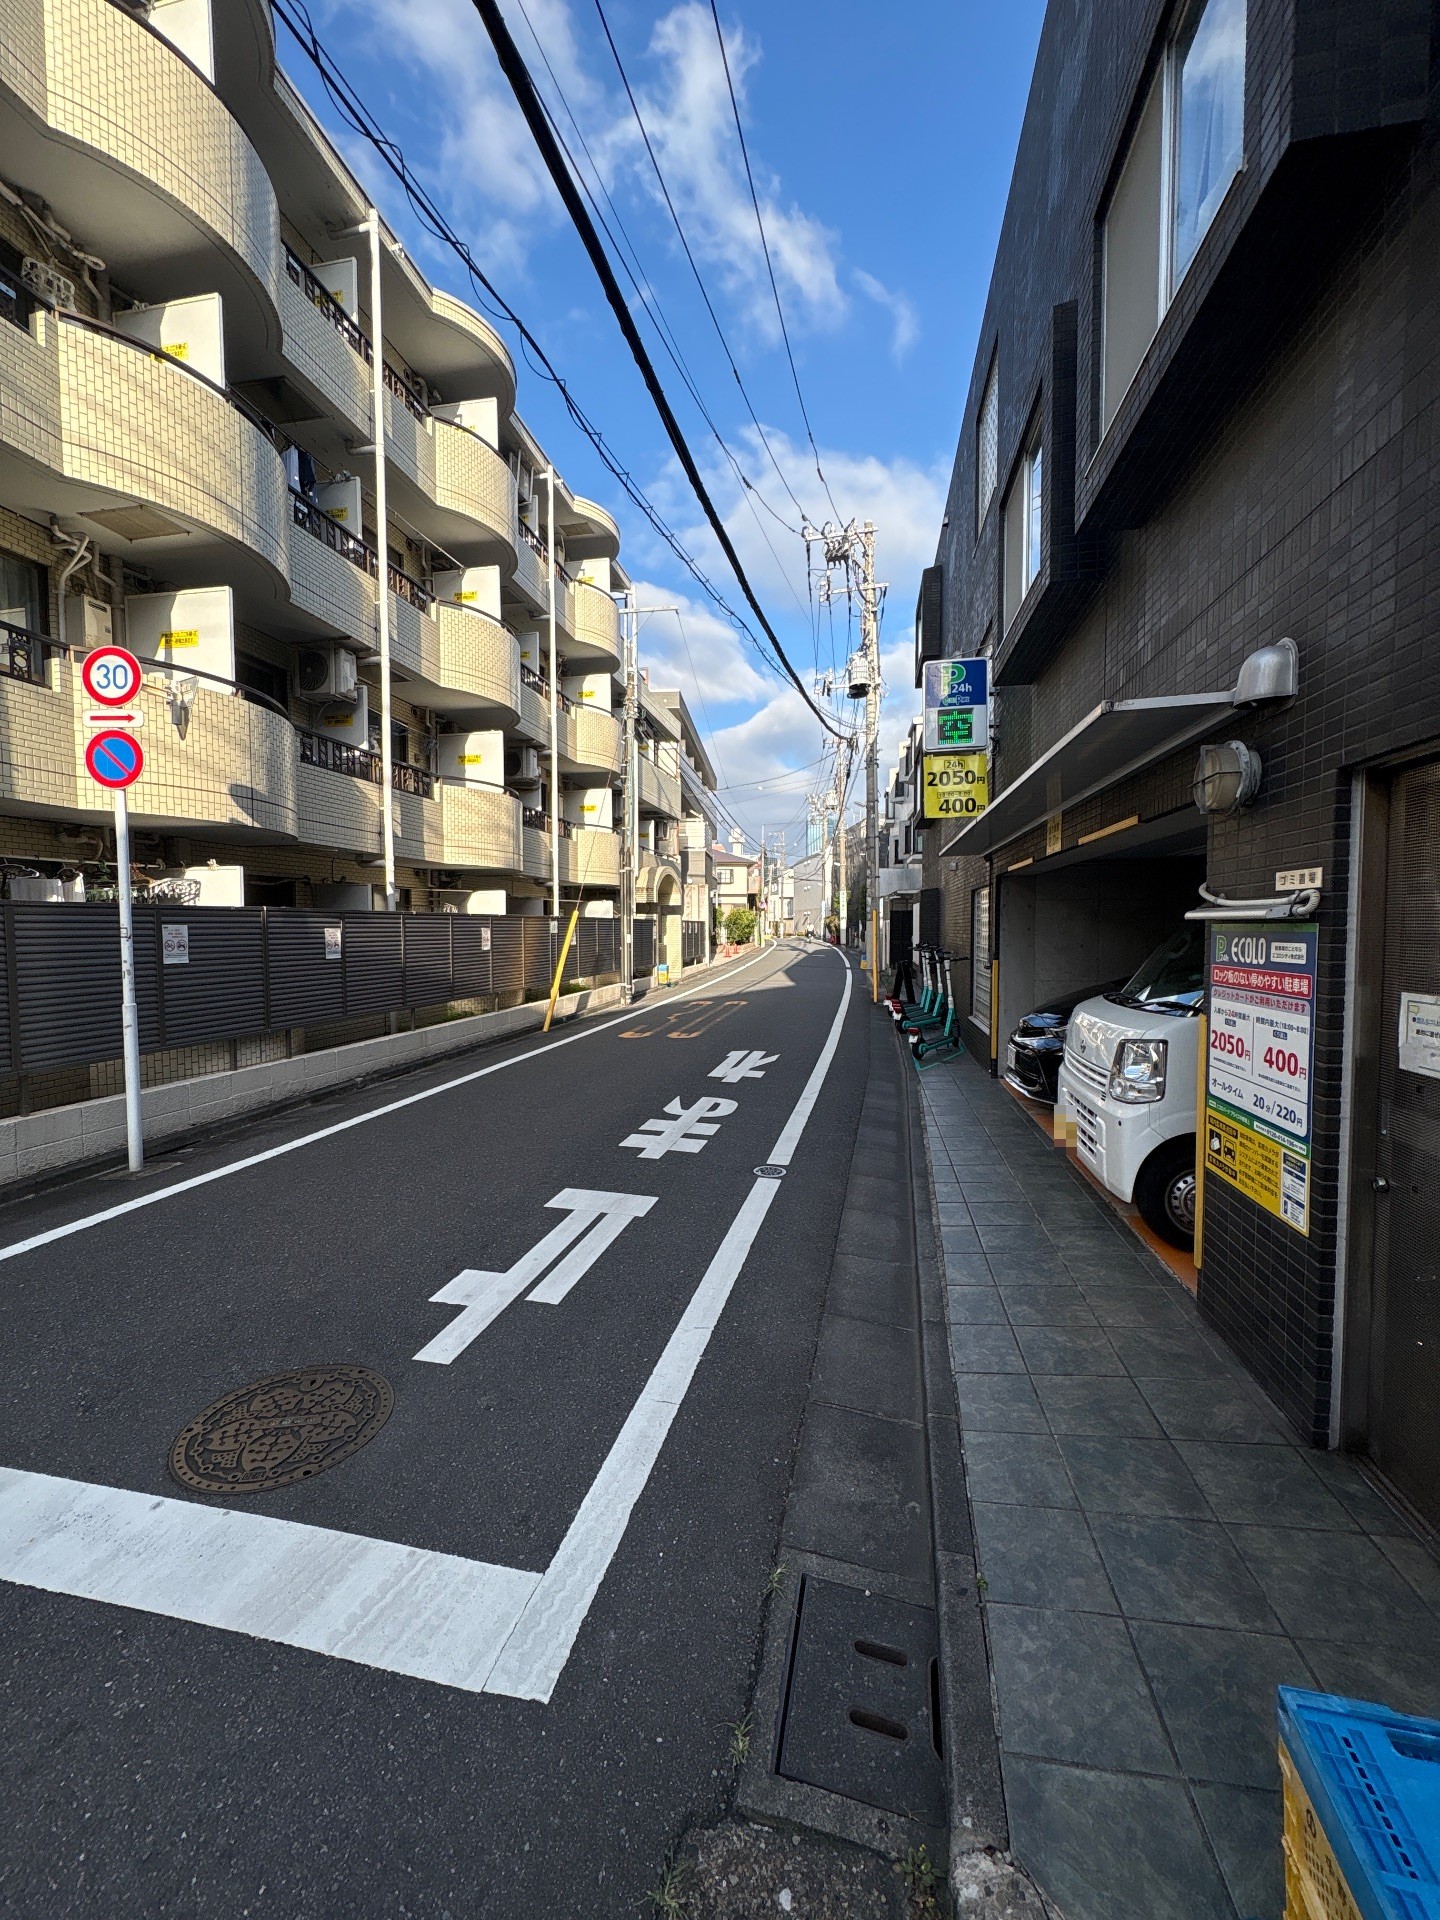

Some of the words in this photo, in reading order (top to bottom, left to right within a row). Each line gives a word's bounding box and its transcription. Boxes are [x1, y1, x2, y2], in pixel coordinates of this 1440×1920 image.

[96, 663, 128, 689] 30
[940, 663, 966, 695] P
[952, 683, 972, 693] 24h
[946, 760, 964, 769] 24h
[927, 769, 985, 787] 2050円
[938, 798, 985, 814] 400円
[1215, 935, 1226, 962] P
[1231, 936, 1267, 965] ECOLO
[1213, 969, 1309, 995] ロック板のない停めやすい駐車場
[1213, 988, 1307, 1014] クレジットカードがご利用いただけます
[618, 1000, 750, 1039] 30
[1210, 1029, 1251, 1061] 2050円
[1263, 1046, 1307, 1080] 400円
[1211, 1077, 1244, 1099] オールタイム
